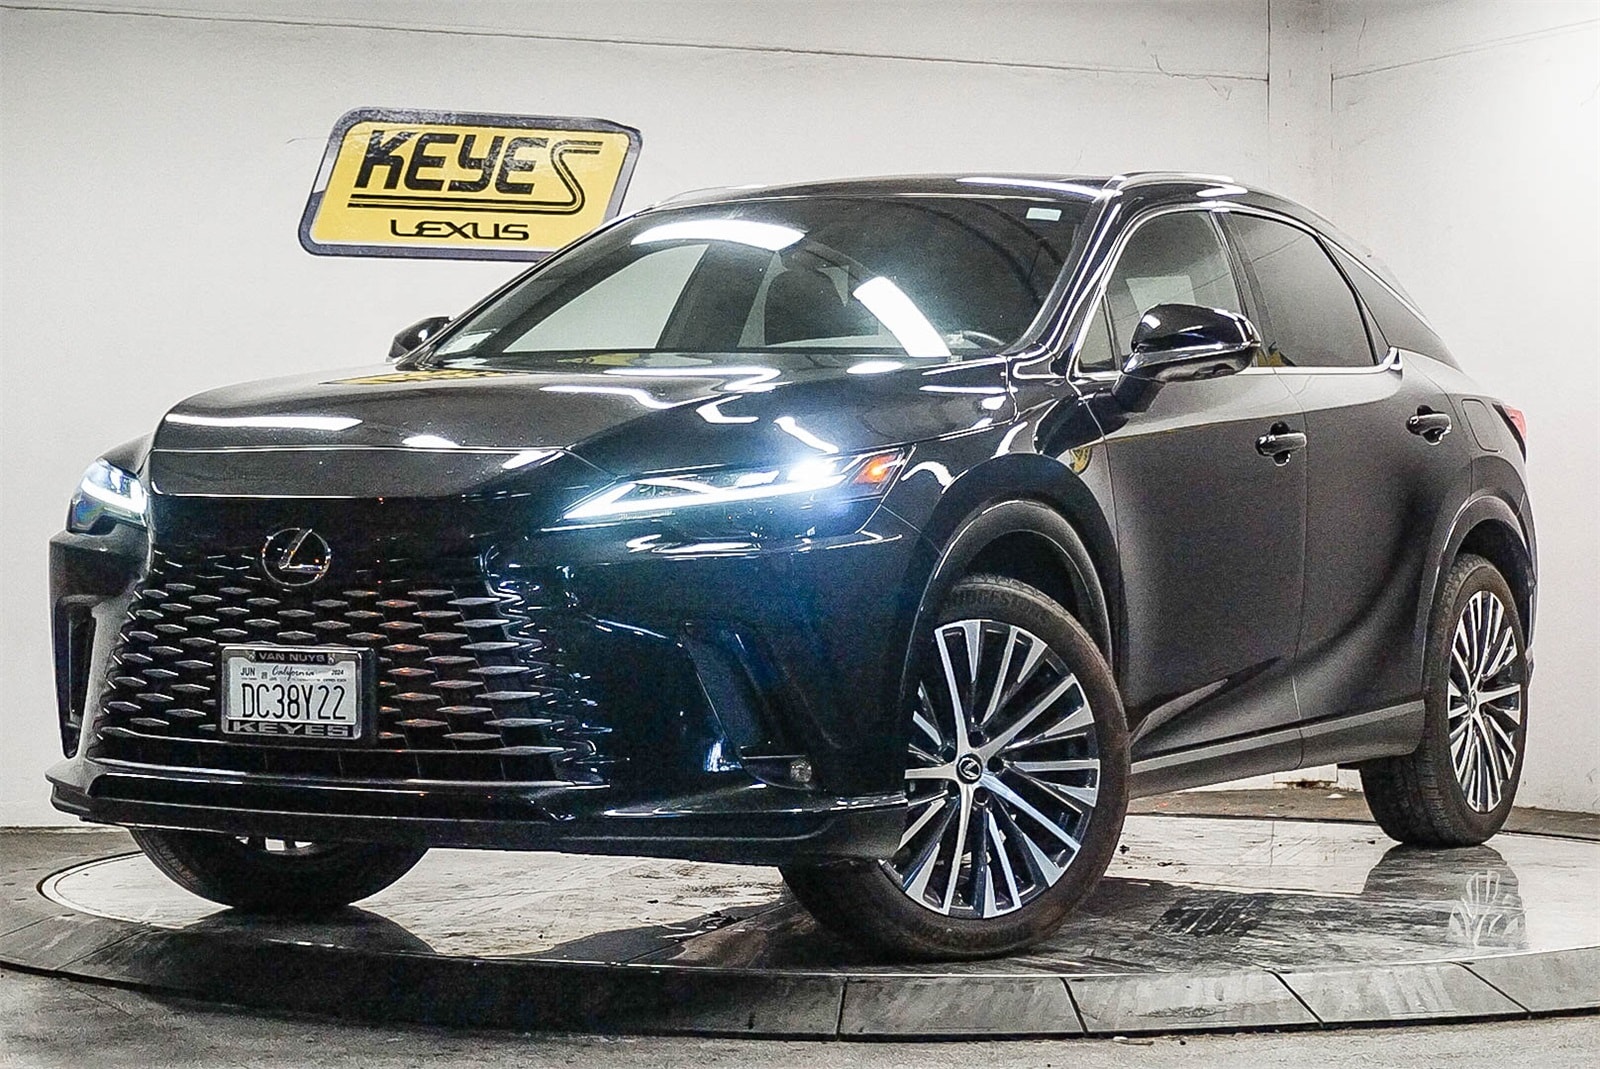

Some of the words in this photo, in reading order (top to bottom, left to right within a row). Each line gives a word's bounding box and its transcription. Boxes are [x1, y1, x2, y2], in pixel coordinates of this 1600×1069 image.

[353, 129, 604, 208] KEYES
[389, 219, 530, 241] LEXUS
[258, 652, 285, 662] VAN
[289, 653, 326, 663] NUYS
[240, 667, 256, 677] JUN
[271, 664, 315, 682] California
[241, 682, 346, 720] DC38Y22
[232, 721, 349, 737] KEYES
